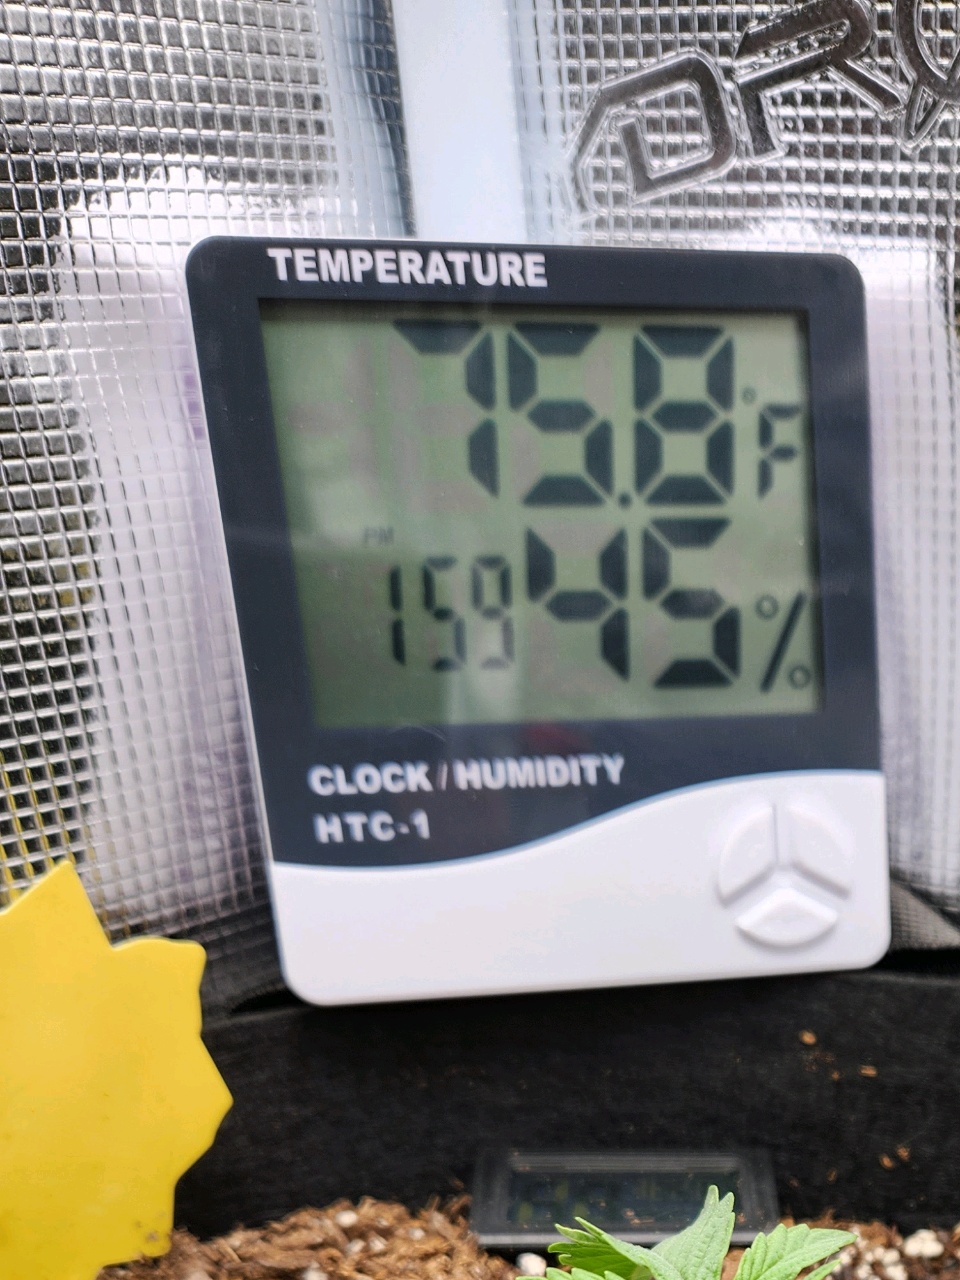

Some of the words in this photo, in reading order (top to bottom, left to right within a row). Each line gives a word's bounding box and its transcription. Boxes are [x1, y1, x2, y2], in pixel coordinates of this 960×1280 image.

[267, 247, 549, 288] TEMPERATURE
[307, 761, 434, 797] CLOCK
[453, 752, 625, 791] HUMIDITY
[312, 808, 431, 844] HTC-1
